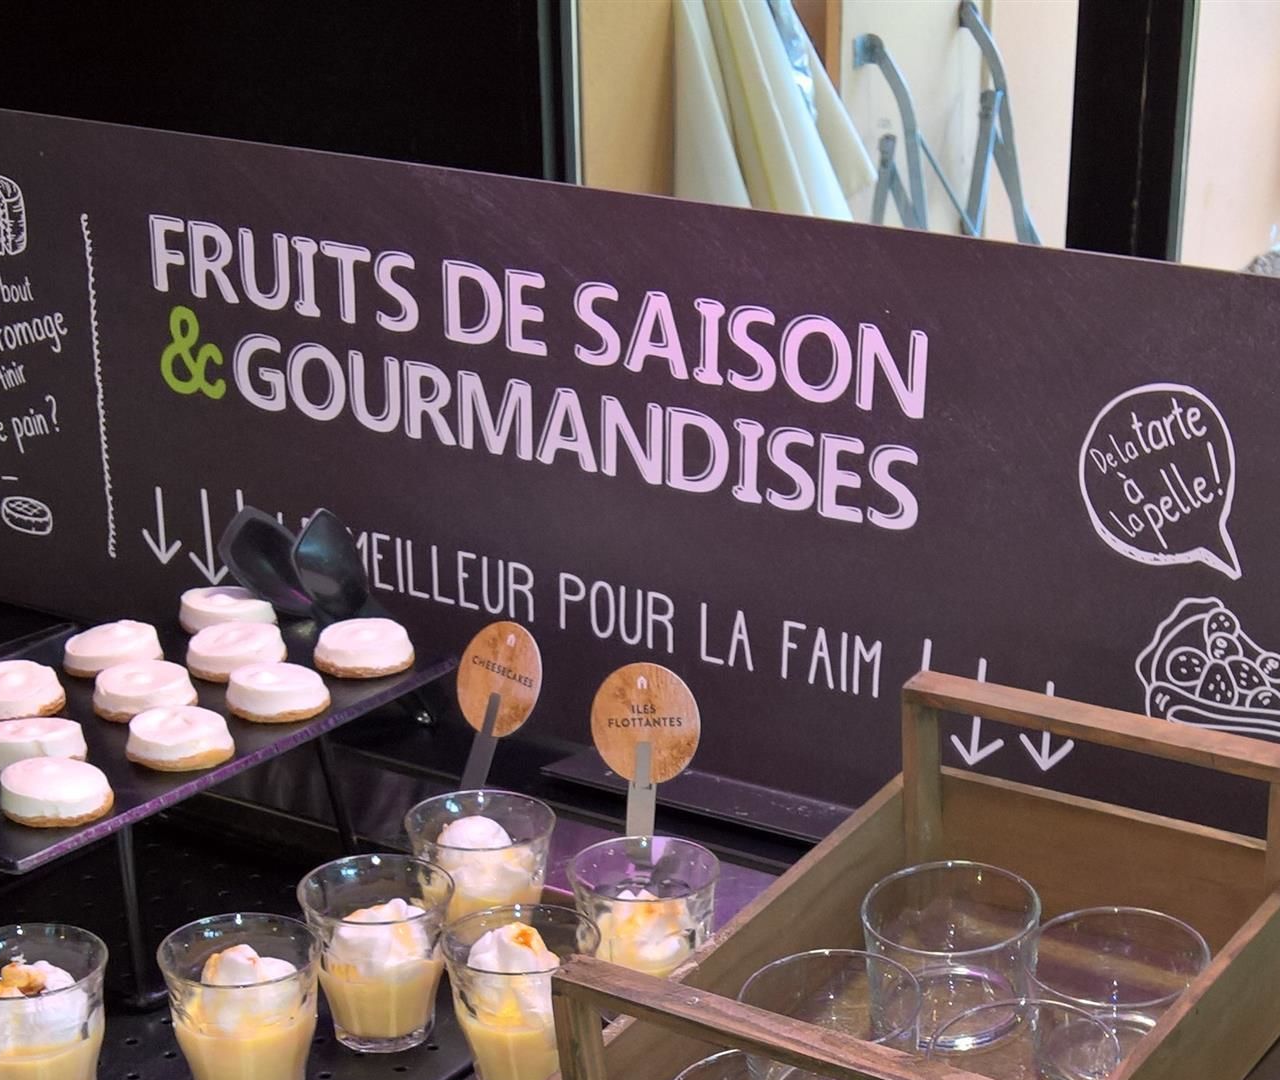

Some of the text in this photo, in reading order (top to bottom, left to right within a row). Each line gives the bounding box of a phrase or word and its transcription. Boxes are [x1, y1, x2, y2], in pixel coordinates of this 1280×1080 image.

[149, 214, 928, 419] FRUITS DE SAISON
[233, 333, 919, 530] GOURMANDISES
[1089, 397, 1207, 474] De la tarte
[1117, 472, 1144, 505] à
[1109, 511, 1145, 538] la
[559, 572, 675, 654] POUR
[700, 602, 754, 672] LA
[781, 620, 883, 698] FAIM
[472, 655, 533, 689] CHEESECAKES
[607, 717, 682, 729] FLOTTANTES
[631, 704, 656, 715] ILES
